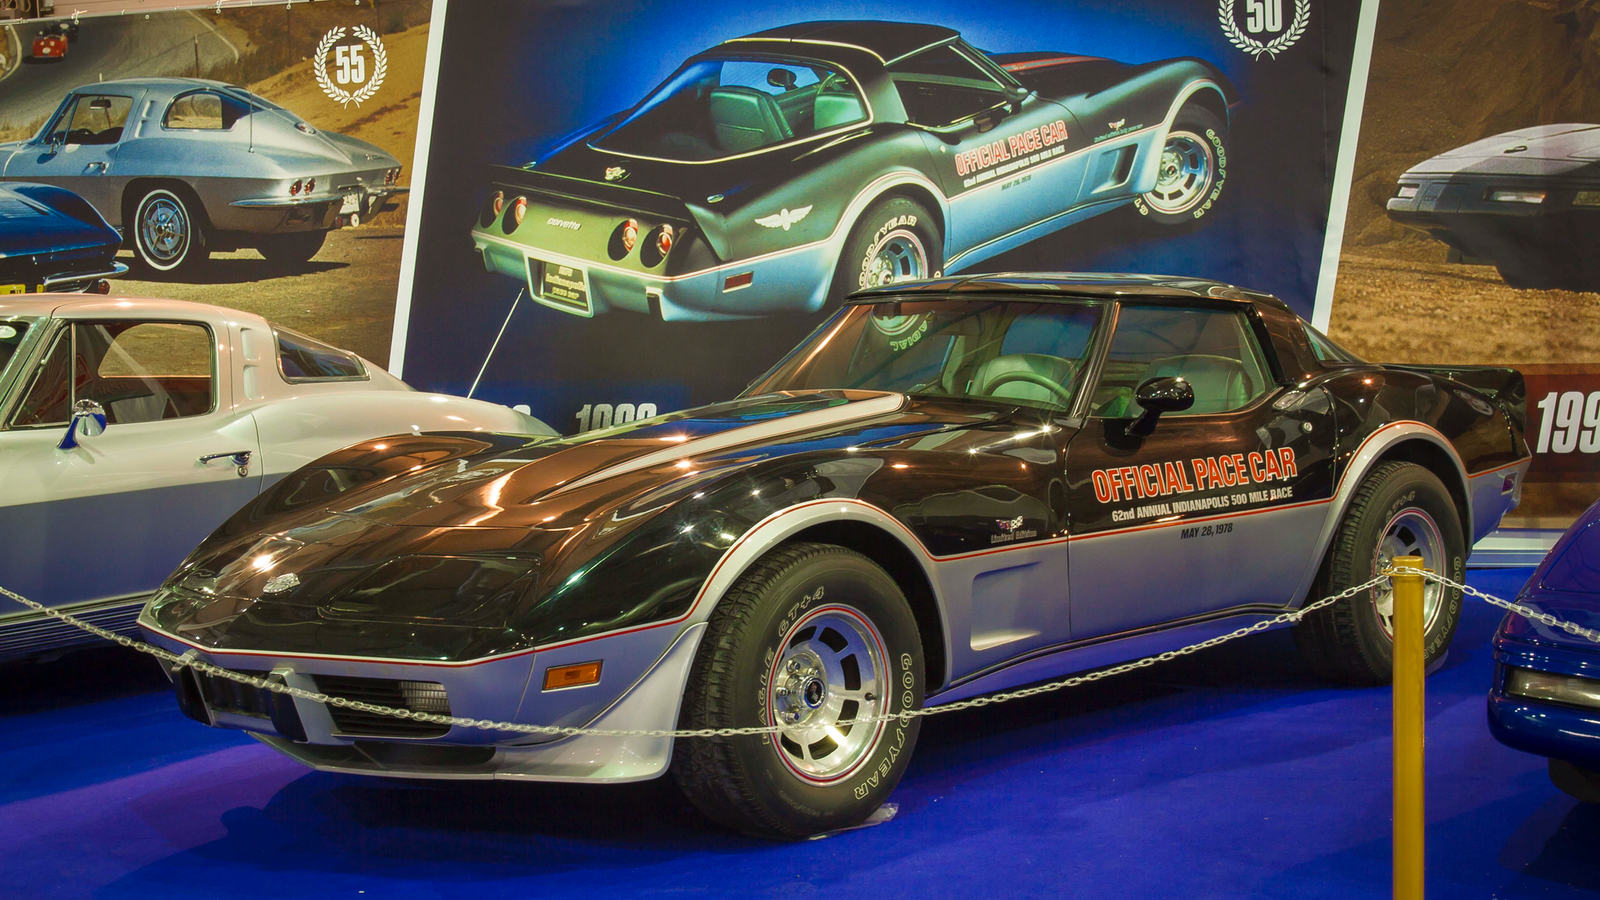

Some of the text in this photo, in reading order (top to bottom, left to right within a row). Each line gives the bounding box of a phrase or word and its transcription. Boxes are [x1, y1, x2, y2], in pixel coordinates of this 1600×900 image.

[1246, 0, 1282, 33] 50
[336, 44, 365, 84] 55
[955, 140, 1011, 176] OFFICIAL
[1008, 128, 1042, 157] PACE
[1040, 120, 1068, 147] CAR
[1193, 129, 1226, 218] GOODYEAR
[547, 217, 581, 230] corvette
[859, 215, 917, 290] OODYEAR
[1092, 447, 1298, 503] OFFICIAL PACE CAR
[1112, 486, 1293, 521] 62nd ANNUAL INDIANAPOLIS 500 MILE RACE
[1181, 528, 1199, 539] MAY
[1215, 523, 1233, 534] 1978
[854, 653, 915, 800] GOODYEAR
